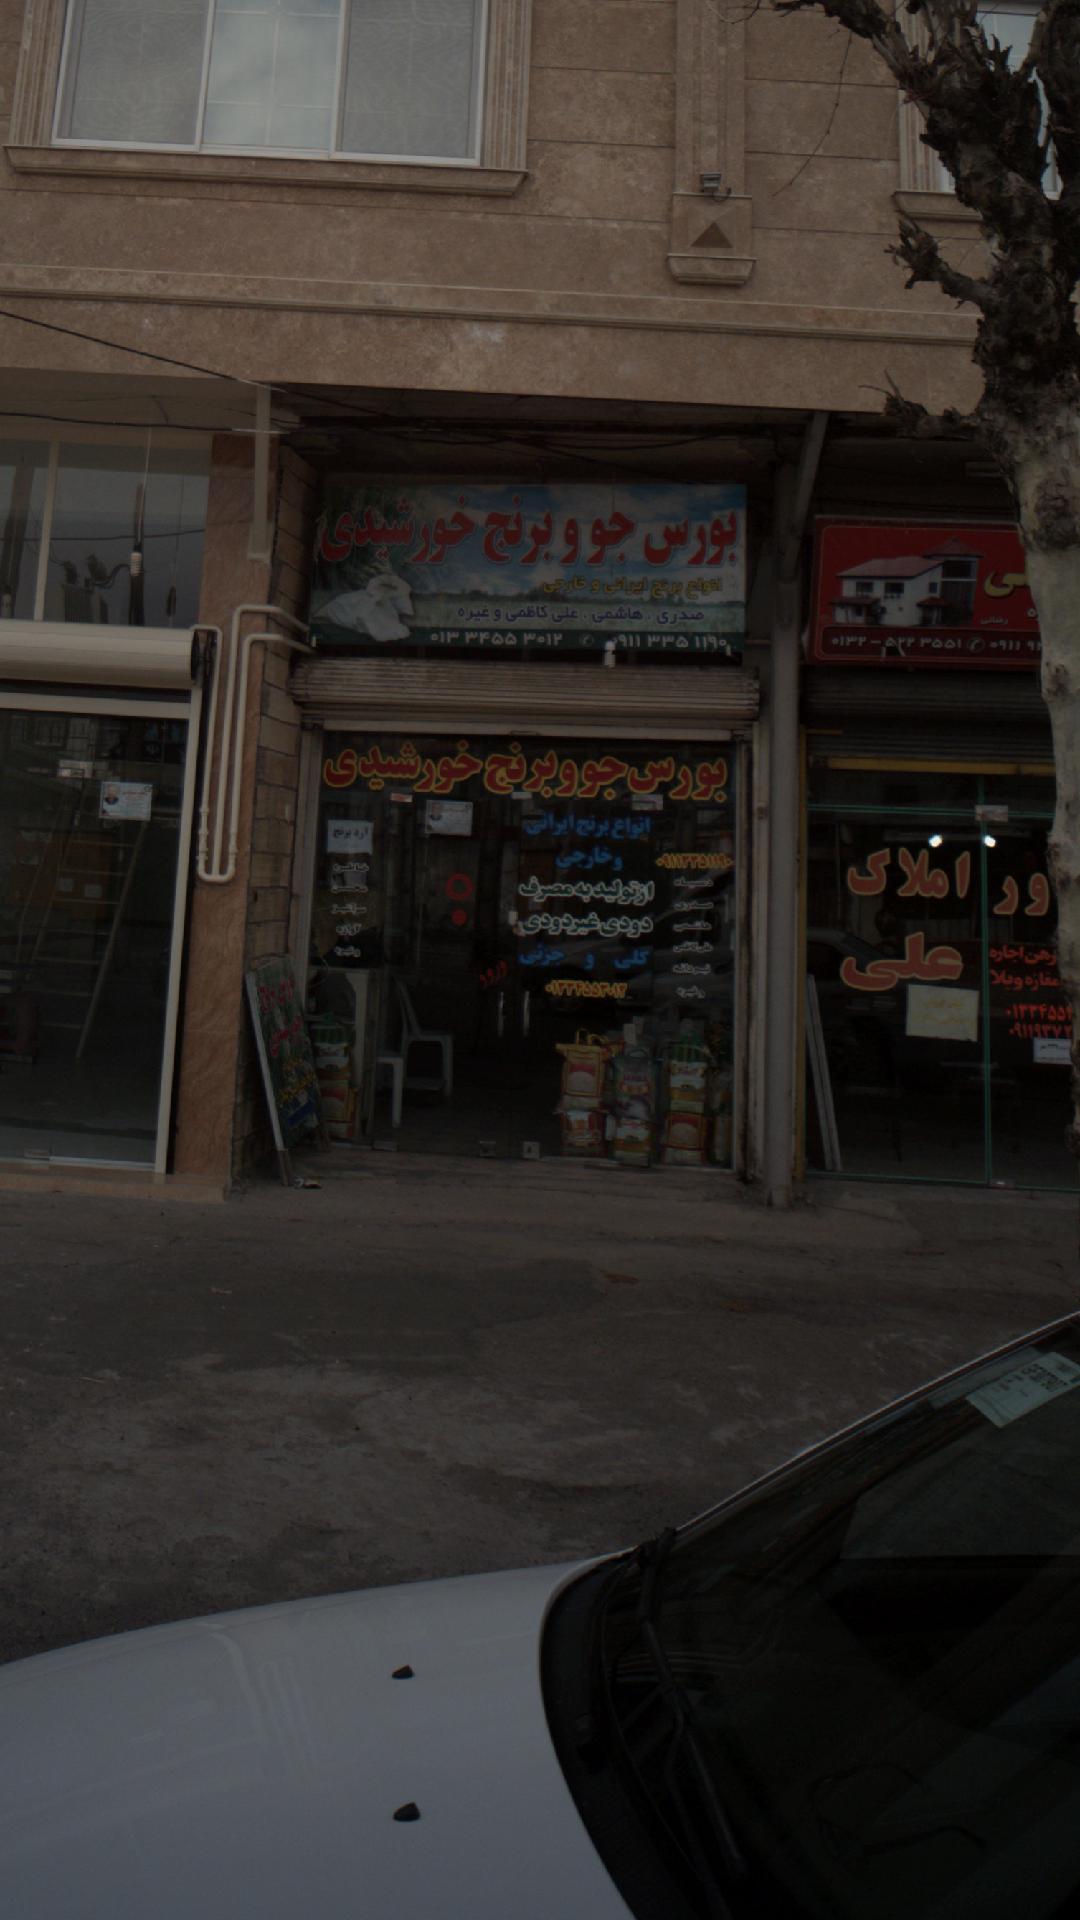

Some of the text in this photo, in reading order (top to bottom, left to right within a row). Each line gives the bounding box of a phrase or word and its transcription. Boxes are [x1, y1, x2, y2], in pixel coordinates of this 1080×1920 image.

[320, 495, 737, 565] بورس جو و برنج خورشیدی
[543, 575, 721, 600] انواع برنج ایرانی و خارجی
[457, 605, 705, 624] صدری هاشمی علی کاظمی و غیره
[430, 631, 460, 644] ۰۱۳
[464, 632, 518, 646] ۳۴۵۵
[523, 633, 563, 646] ۳۰۱۲
[647, 634, 689, 648] ۳۳۵
[323, 739, 728, 803] بورس جو و برنج خورشیدی
[524, 811, 652, 840] انواع برنج ایرانی
[555, 845, 612, 870] خارجی
[847, 847, 971, 899] املاک
[518, 875, 574, 902] مصرف
[583, 951, 596, 971] و
[612, 945, 654, 970] کلی
[840, 931, 964, 992] علی
